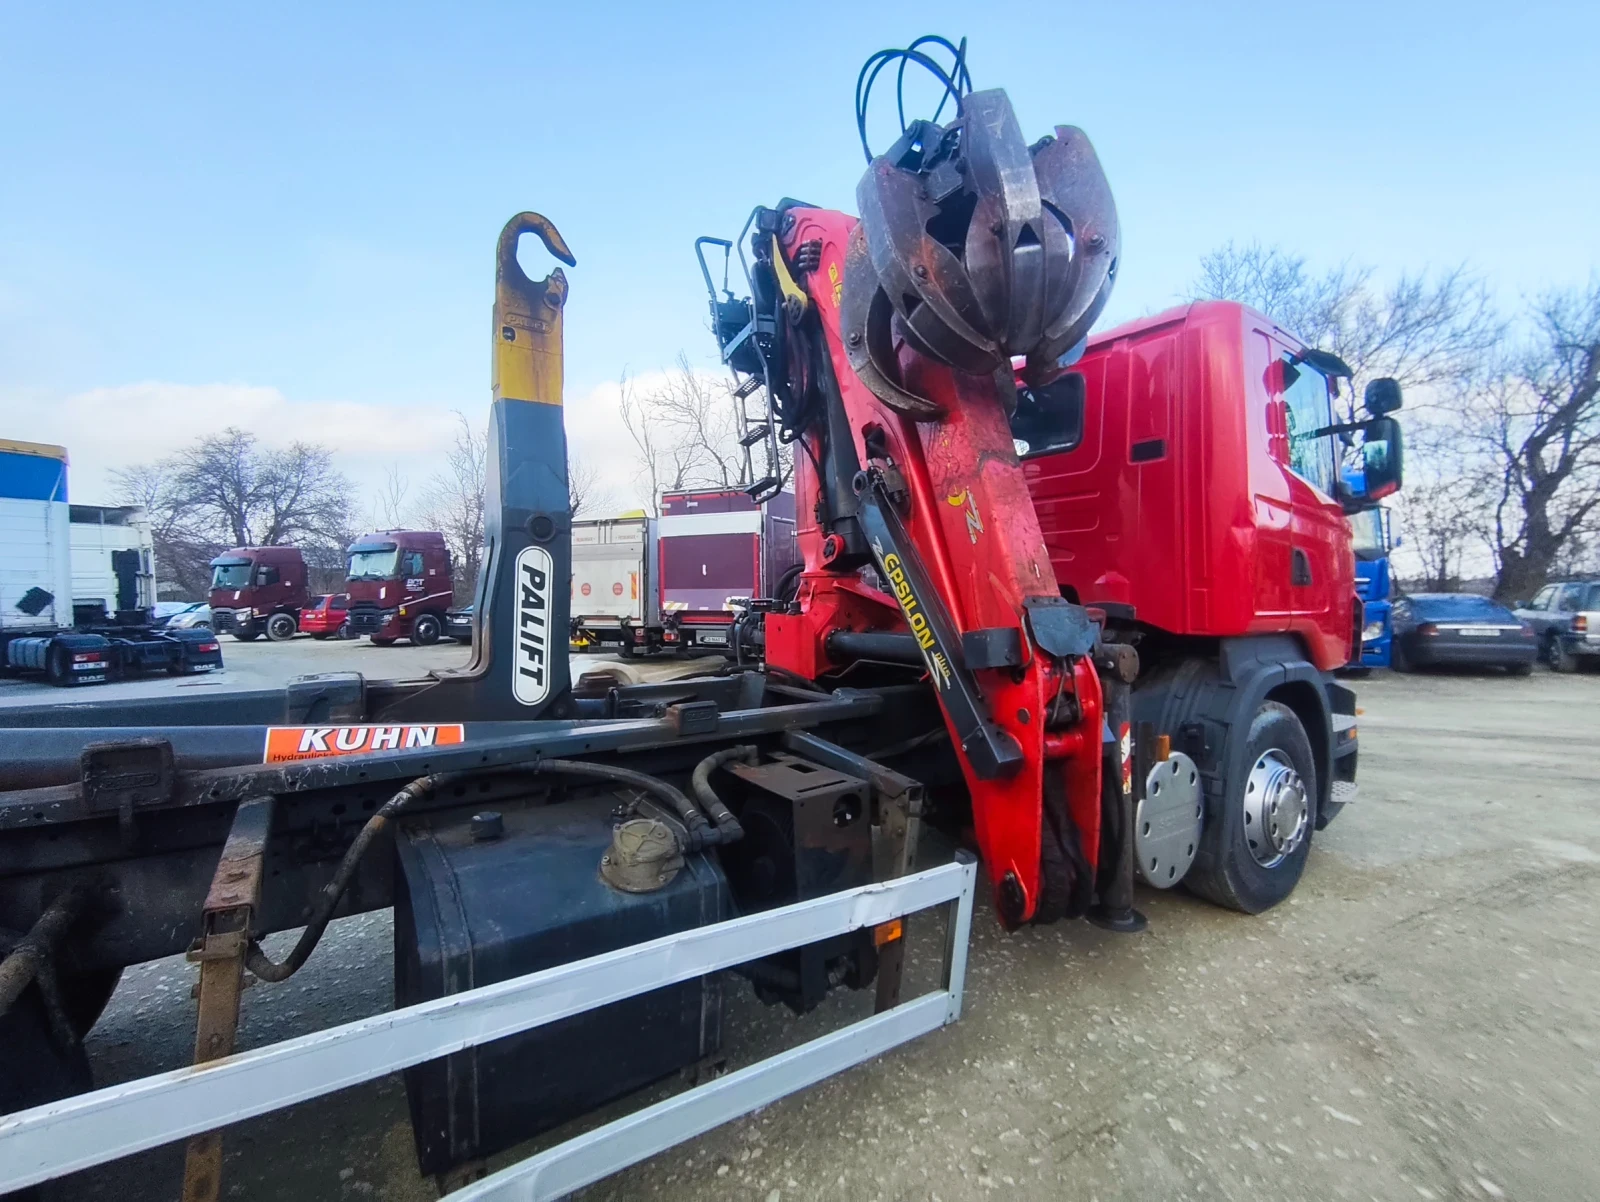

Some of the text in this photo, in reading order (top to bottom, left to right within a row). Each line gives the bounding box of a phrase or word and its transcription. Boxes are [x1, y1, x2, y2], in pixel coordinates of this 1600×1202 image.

[518, 563, 546, 687] PALIFT
[883, 553, 936, 651] EPSILON
[934, 652, 951, 678] plus
[298, 726, 438, 752] KUHN
